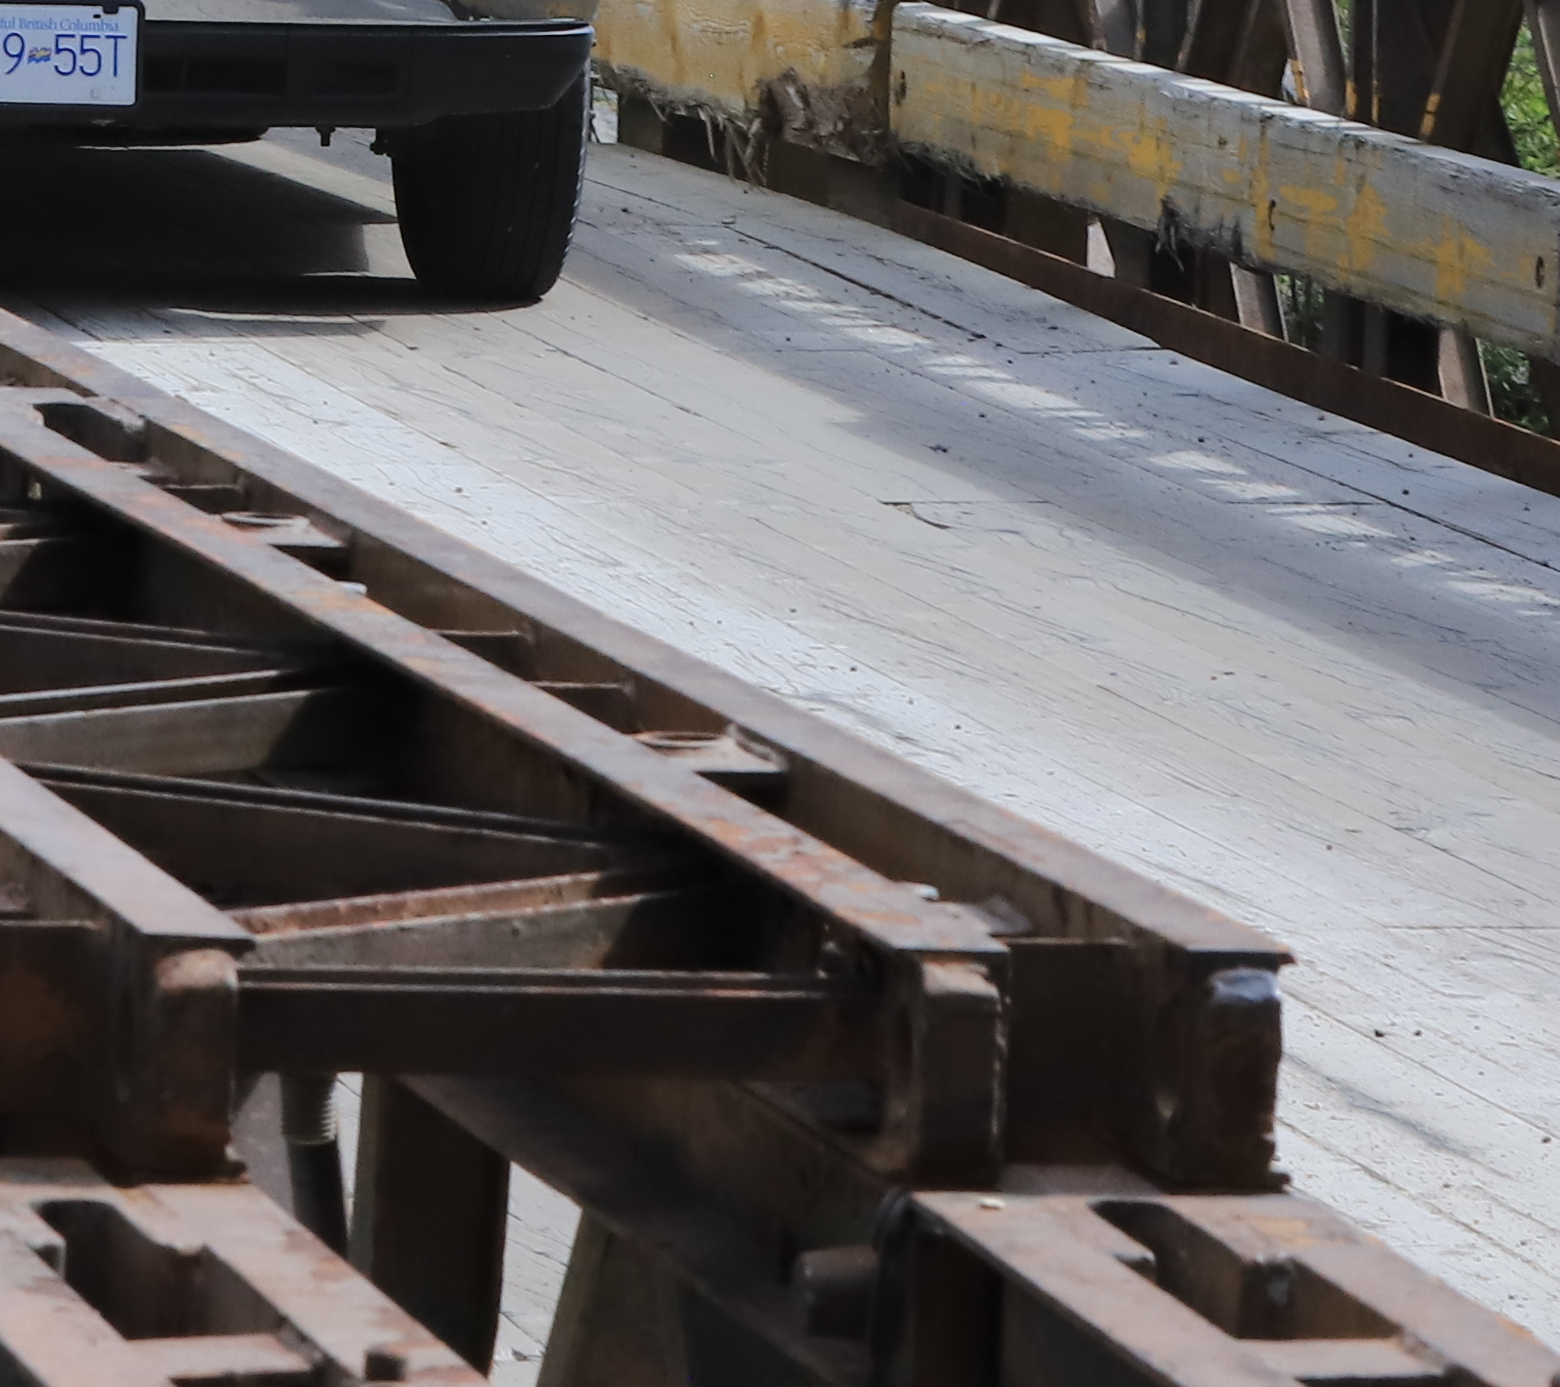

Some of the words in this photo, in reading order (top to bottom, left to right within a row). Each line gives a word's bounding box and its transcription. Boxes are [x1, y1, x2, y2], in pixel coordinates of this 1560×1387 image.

[19, 17, 56, 30] British
[59, 18, 119, 31] Columbia
[54, 34, 128, 77] 55T
